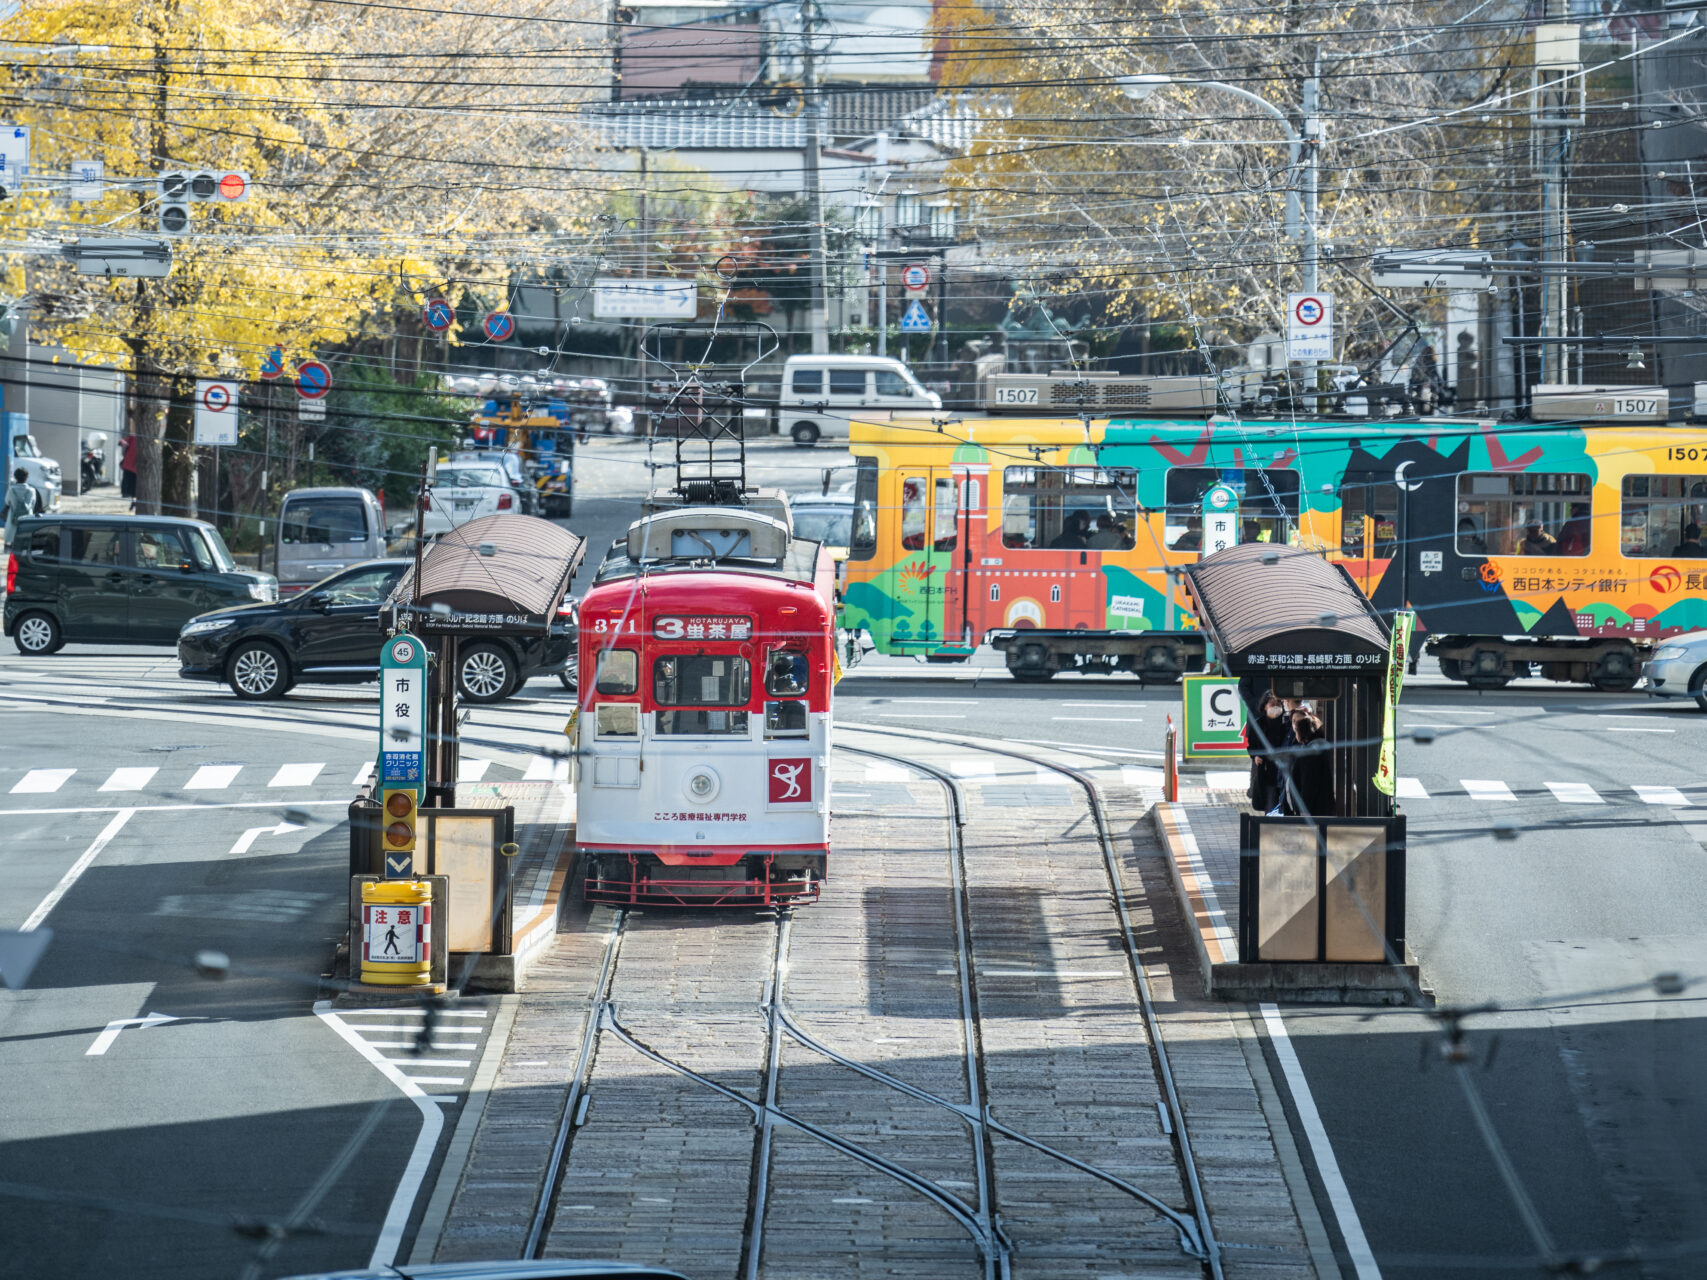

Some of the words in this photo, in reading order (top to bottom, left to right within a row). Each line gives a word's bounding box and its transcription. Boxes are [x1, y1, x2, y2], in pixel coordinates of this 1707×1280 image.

[998, 389, 1037, 403] 1507
[1616, 400, 1657, 413] 1507
[1513, 577, 1628, 593] 西日本シティ銀行
[1685, 574, 1707, 590] 長
[594, 618, 636, 634] 371
[656, 618, 684, 639] 3
[396, 648, 409, 657] 45
[1335, 654, 1352, 664] 方面
[1355, 653, 1381, 664] のりば
[1210, 688, 1233, 716] C
[1207, 718, 1235, 728] ホーム
[654, 812, 747, 822] こころ医療福祉専門学校
[375, 909, 411, 925] 注意
